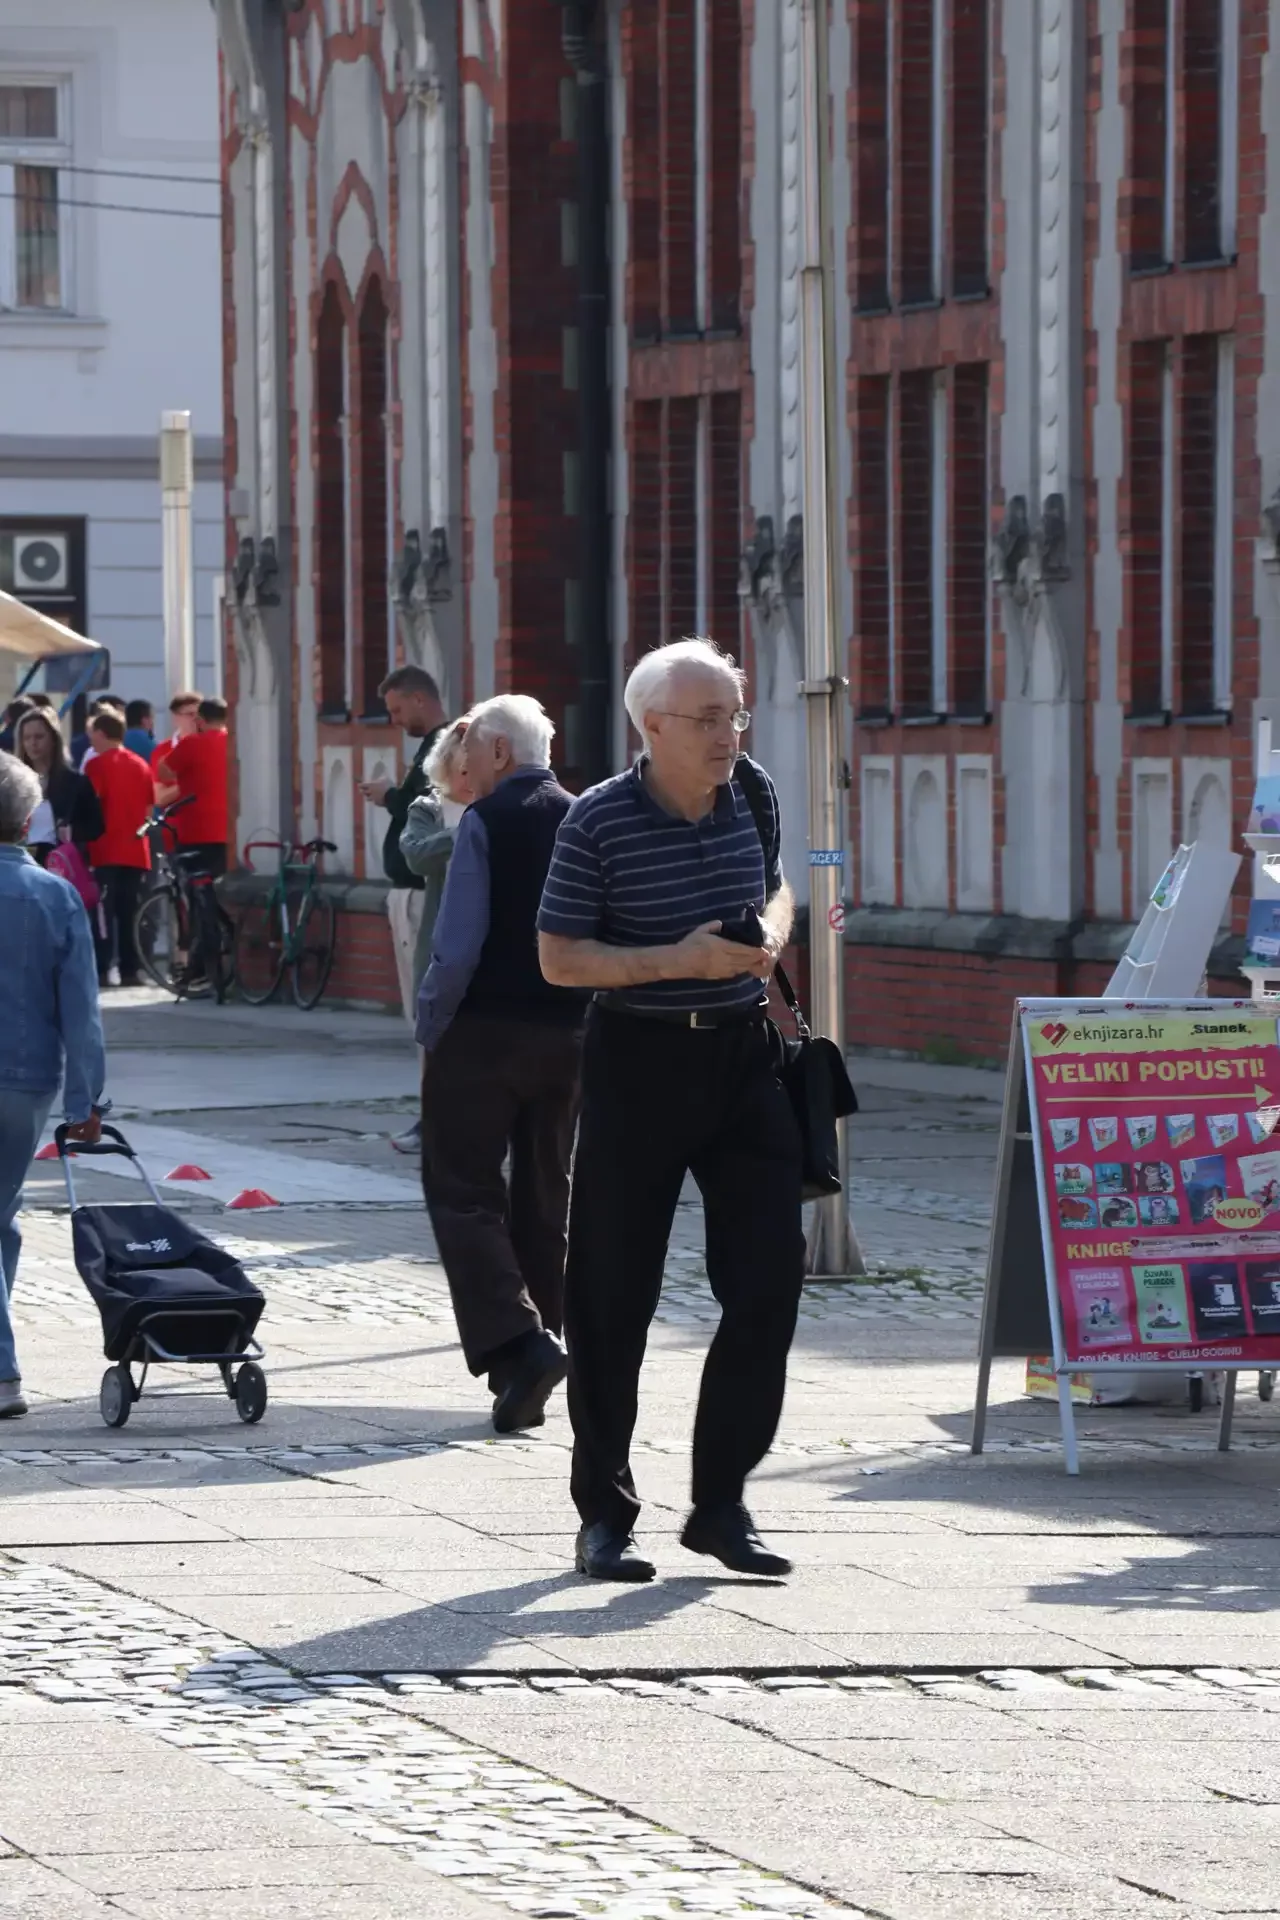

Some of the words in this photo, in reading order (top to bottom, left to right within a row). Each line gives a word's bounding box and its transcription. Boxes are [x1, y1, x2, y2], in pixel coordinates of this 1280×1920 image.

[1073, 1025, 1165, 1043] eknjizara.hr
[1041, 1062, 1128, 1084] VELIKI
[1139, 1058, 1267, 1082] POPUSTI!
[1215, 1206, 1263, 1220] NOVO!
[1067, 1242, 1132, 1260] KNJIGE
